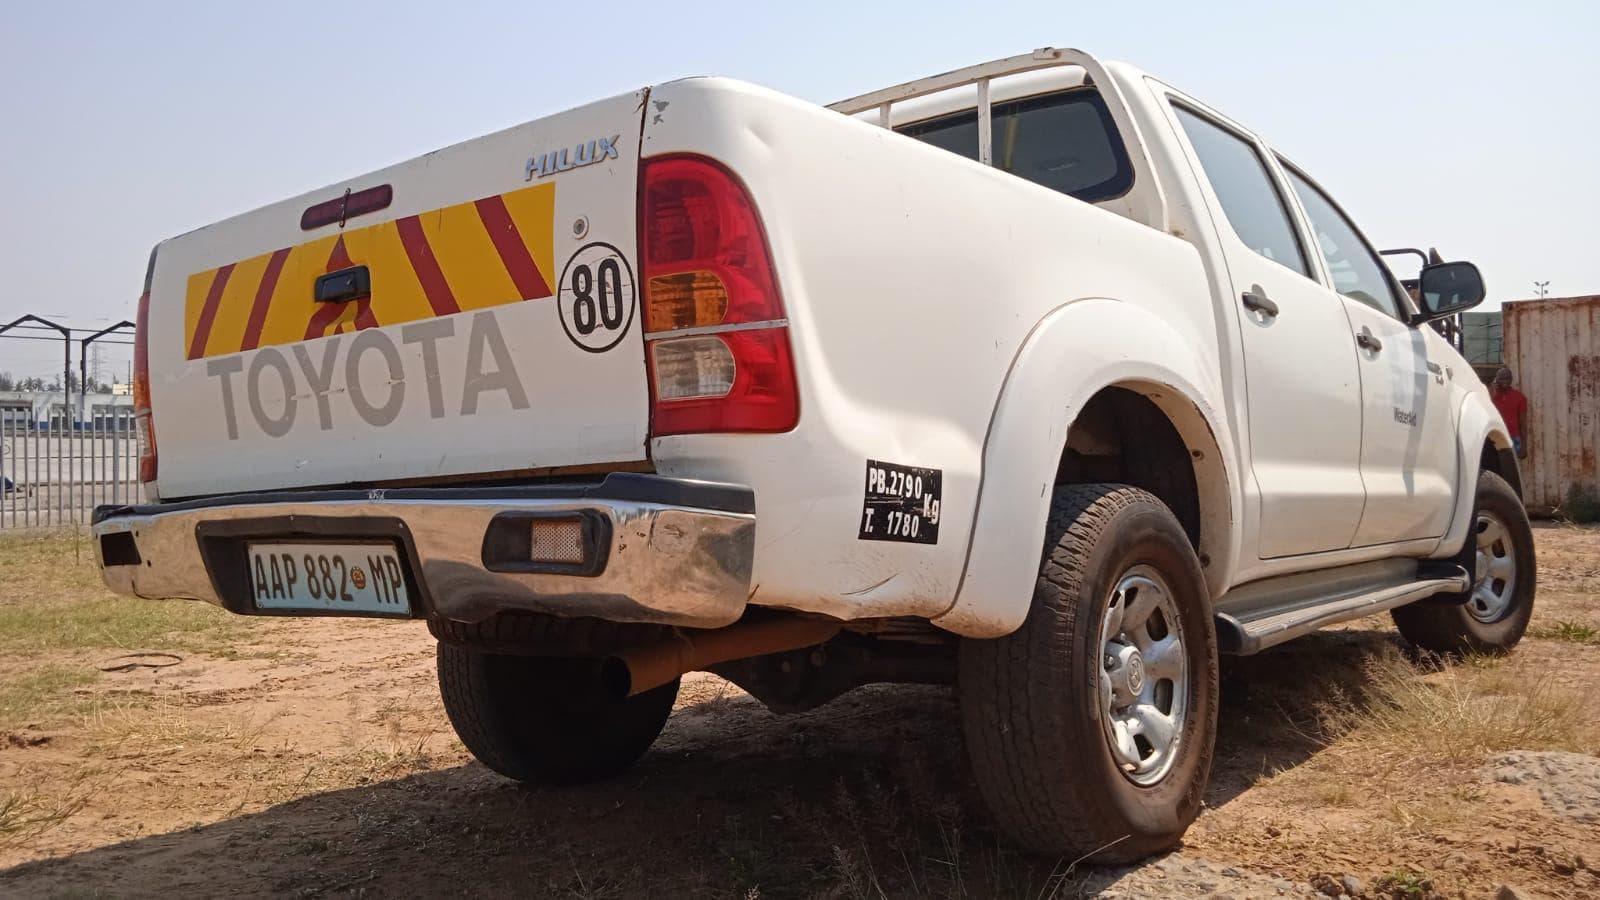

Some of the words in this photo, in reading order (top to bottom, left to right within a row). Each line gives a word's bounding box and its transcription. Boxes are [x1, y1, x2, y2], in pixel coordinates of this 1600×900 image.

[525, 134, 620, 182] HILUX
[572, 258, 624, 335] 80
[206, 310, 531, 441] TOYOTA
[868, 467, 923, 499] PB.2790
[864, 508, 875, 533] T.
[887, 511, 920, 538] 1780
[923, 493, 940, 525] Kg
[255, 553, 297, 600] AAP
[304, 554, 354, 602] 882
[367, 555, 401, 604] MP
